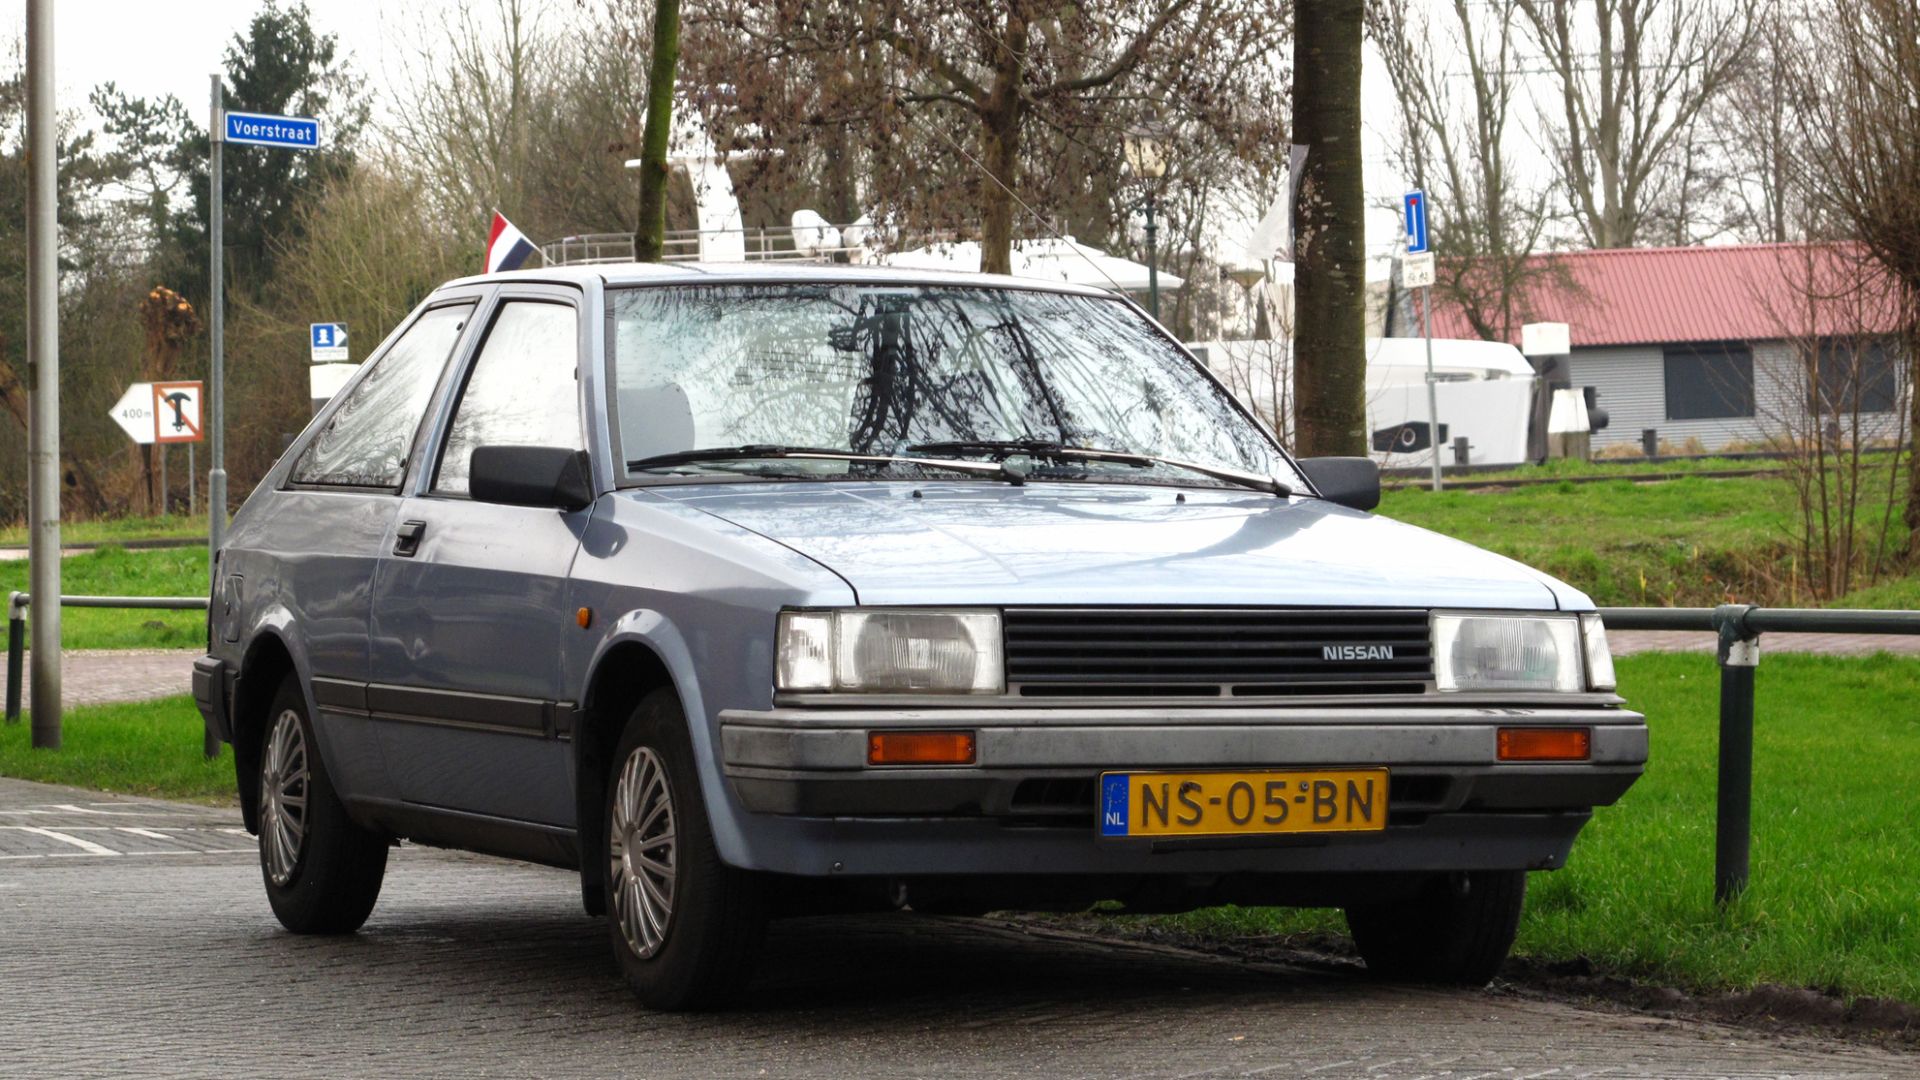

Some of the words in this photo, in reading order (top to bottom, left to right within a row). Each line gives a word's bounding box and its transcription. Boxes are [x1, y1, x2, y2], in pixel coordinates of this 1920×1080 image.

[233, 119, 311, 141] Voerstraat
[1323, 645, 1394, 661] NISSAN
[1142, 779, 1374, 827] NS-05-BN
[1106, 812, 1125, 826] NL
